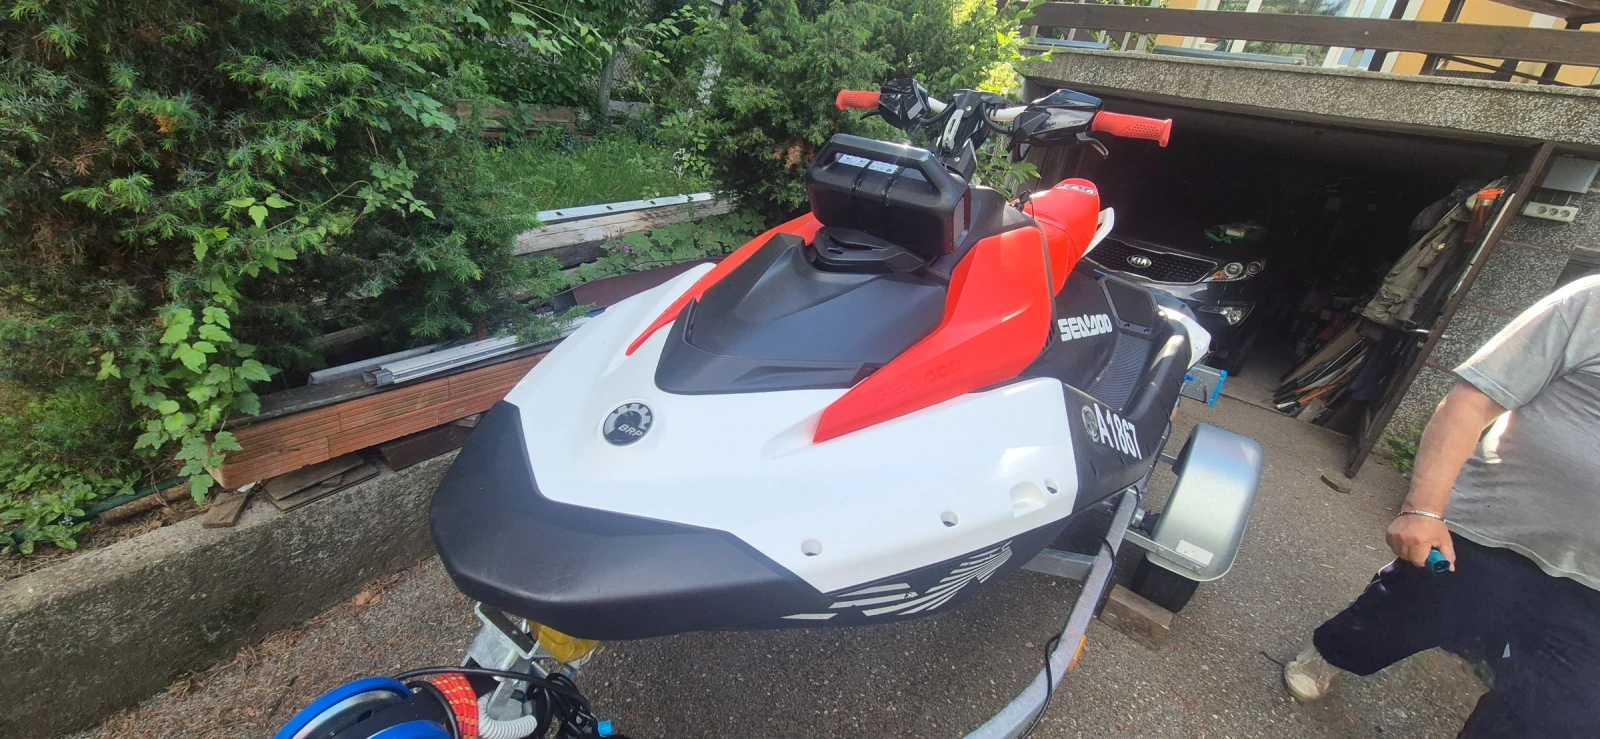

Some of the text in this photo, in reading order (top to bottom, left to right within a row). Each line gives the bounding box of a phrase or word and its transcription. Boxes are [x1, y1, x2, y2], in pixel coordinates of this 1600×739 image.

[1131, 255, 1148, 266] KIA
[618, 424, 643, 436] BRP
[1094, 403, 1142, 460] A1867
